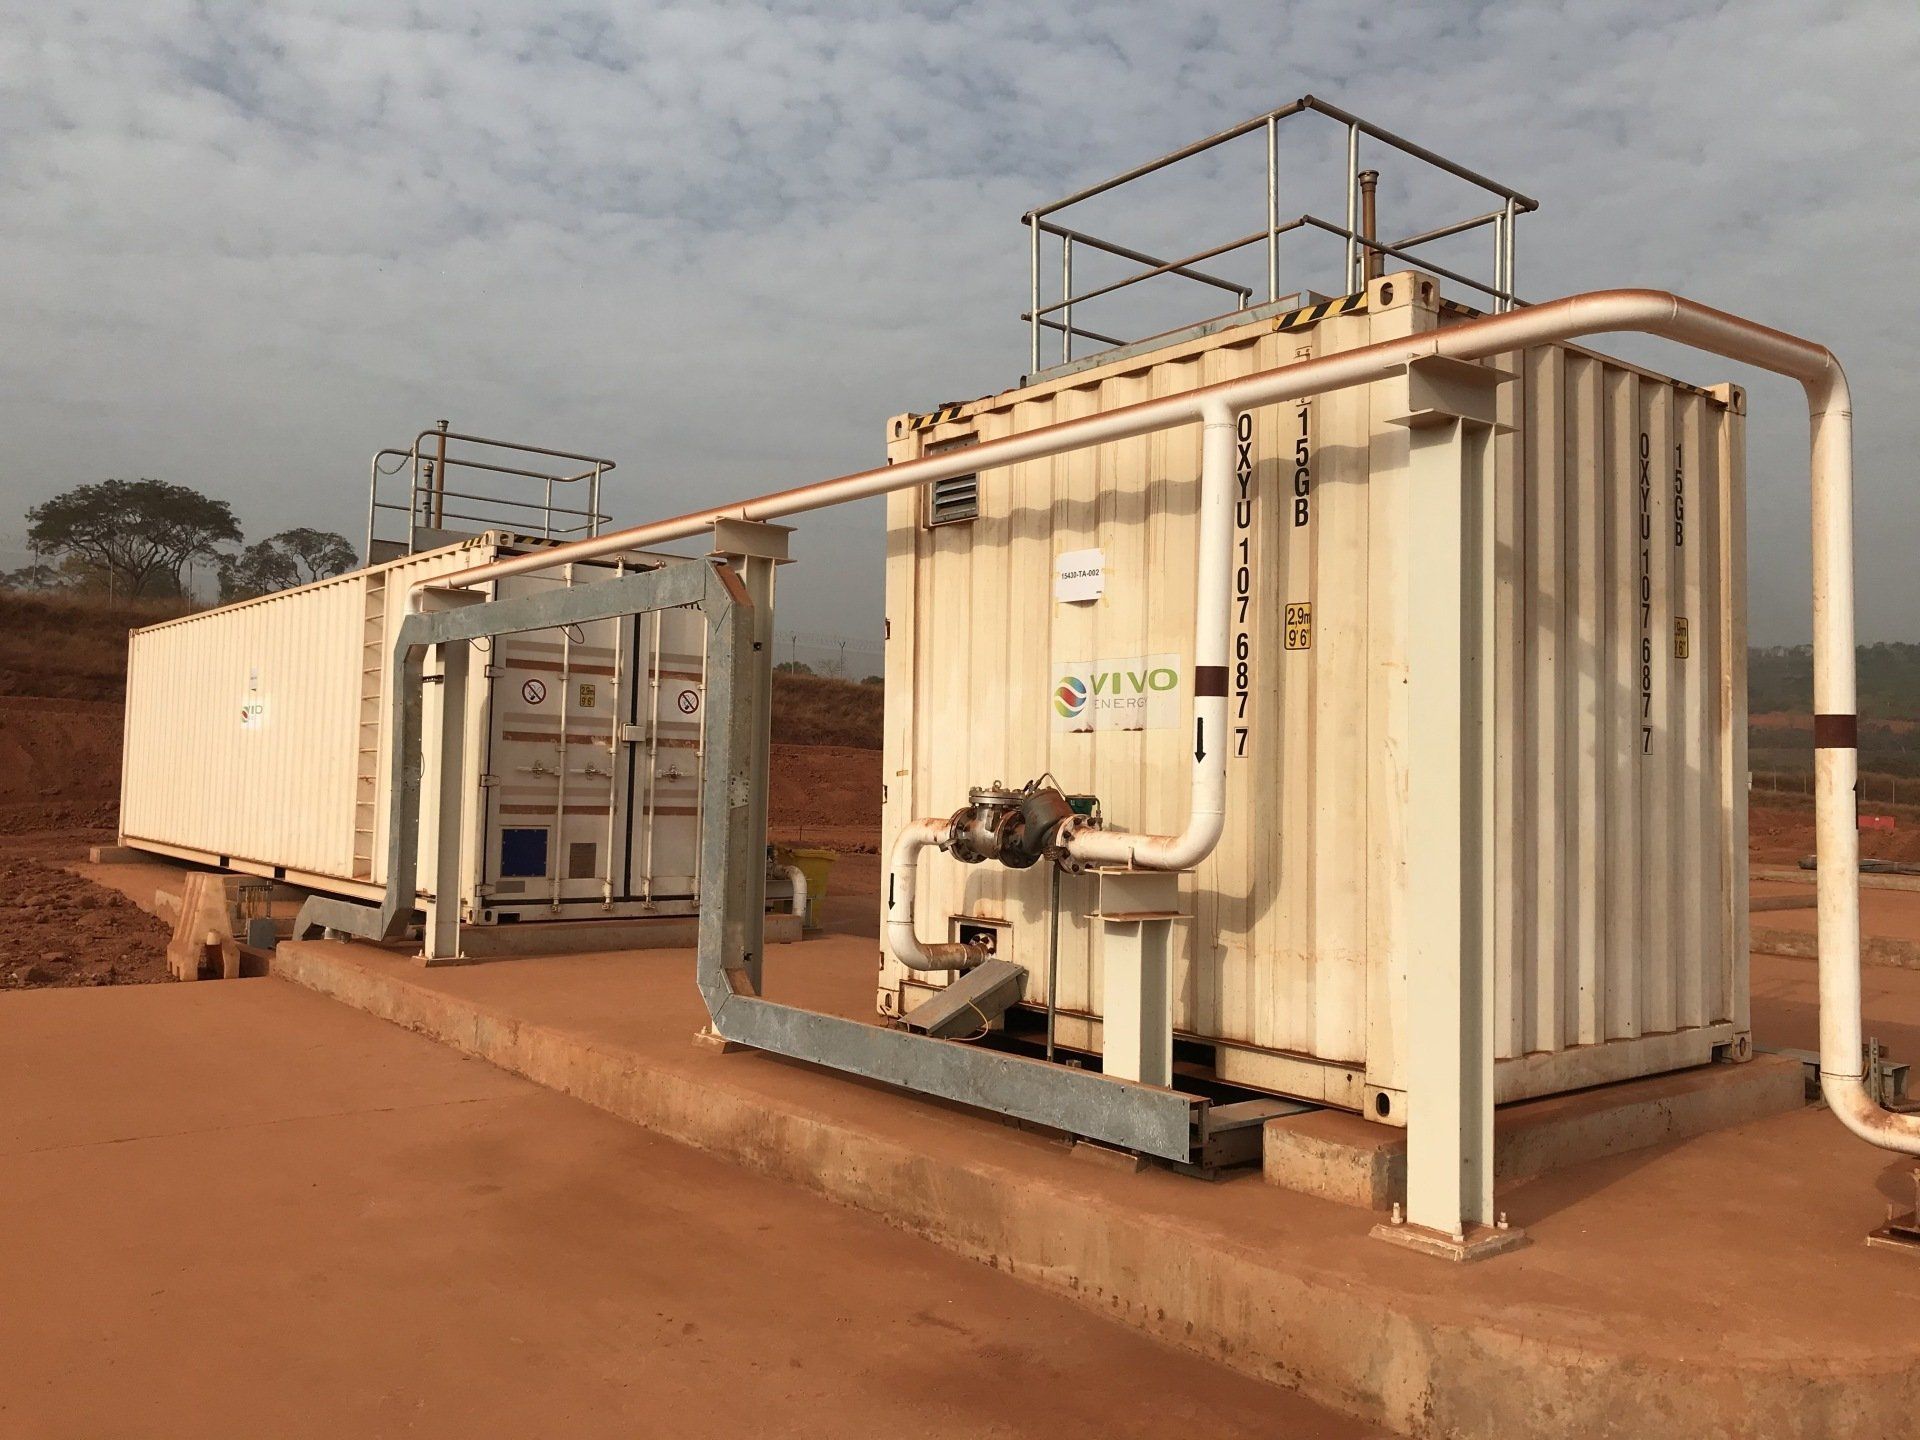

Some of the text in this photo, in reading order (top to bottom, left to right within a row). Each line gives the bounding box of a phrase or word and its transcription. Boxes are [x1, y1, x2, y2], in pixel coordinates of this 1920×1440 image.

[1236, 413, 1252, 529] OXYU
[1294, 407, 1310, 528] 15GB
[1640, 432, 1650, 540] OXYU
[1090, 668, 1178, 695] VIVO
[1235, 728, 1248, 756] 7
[1643, 727, 1651, 753] 7
